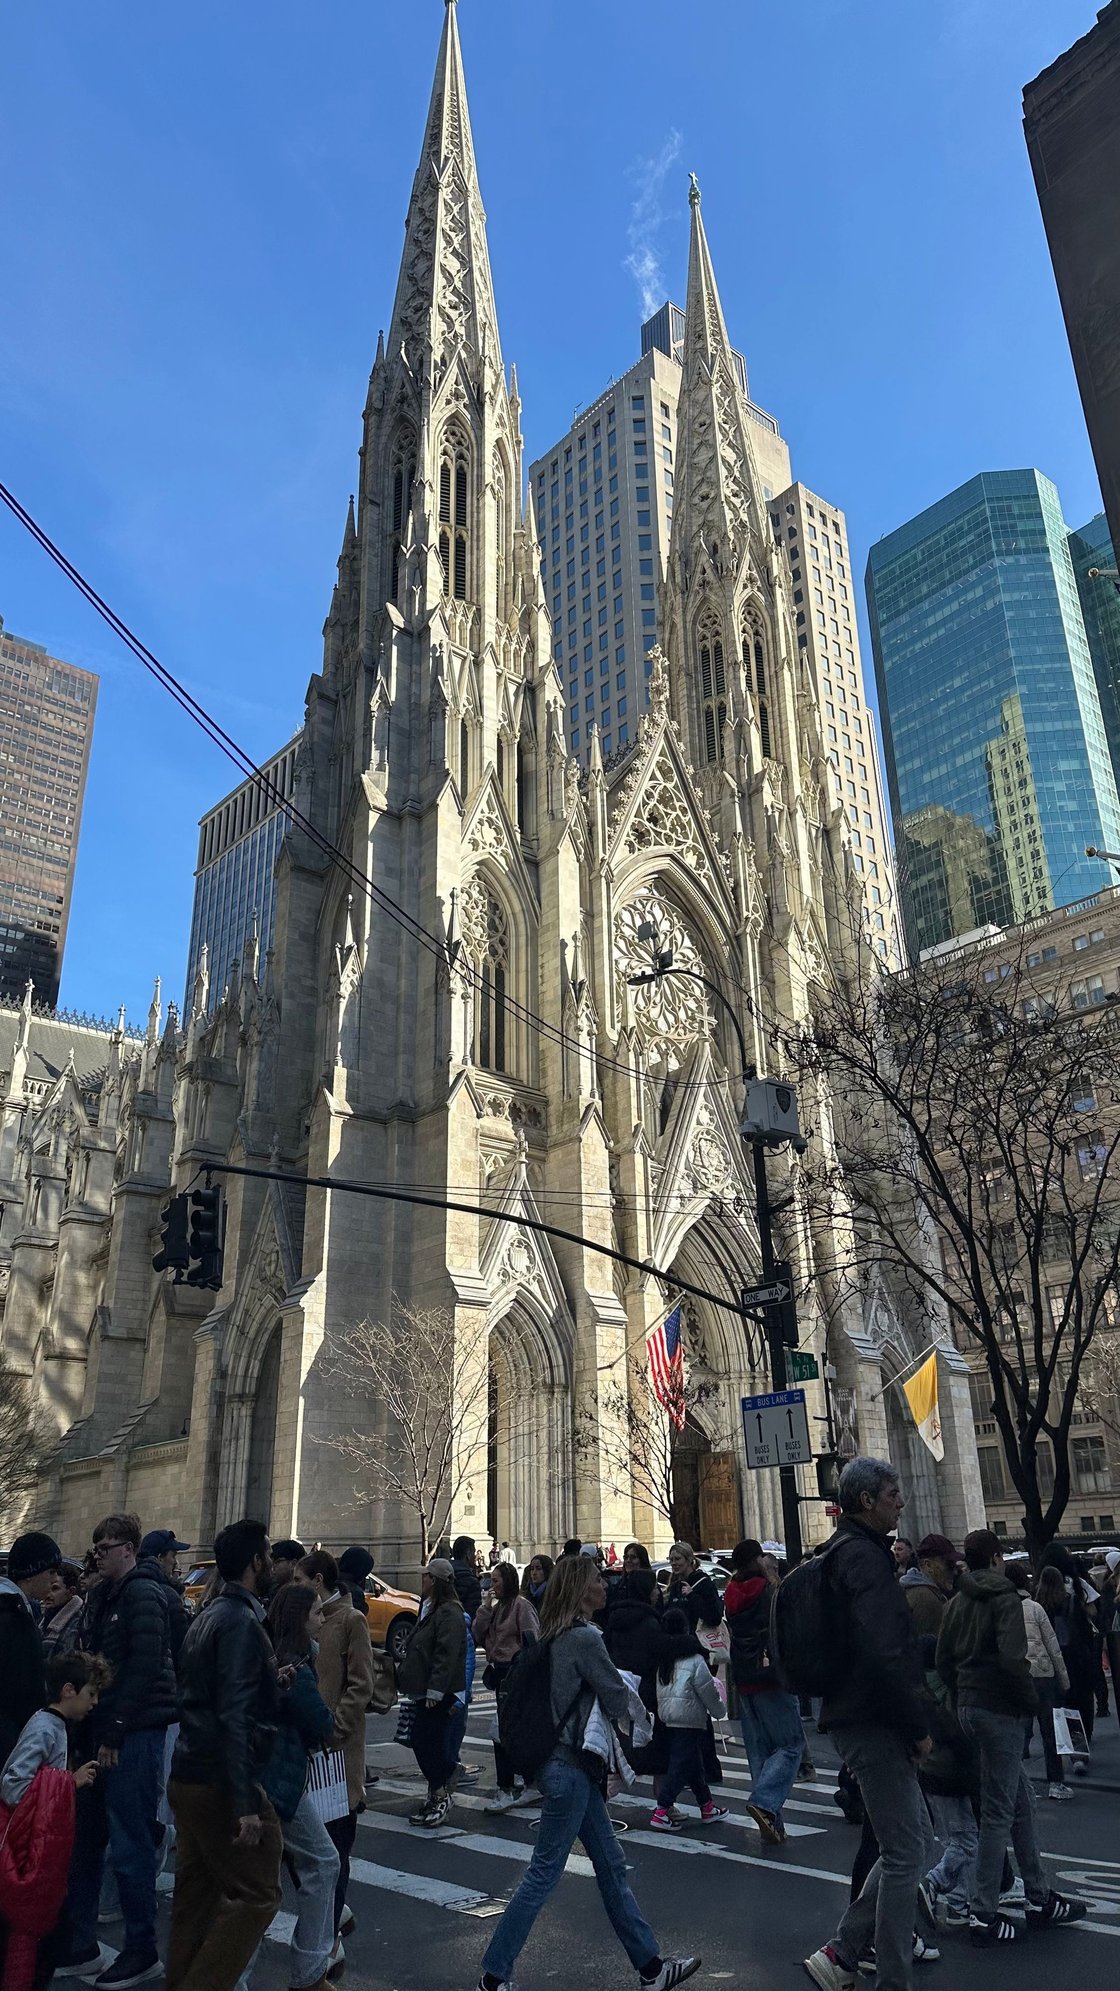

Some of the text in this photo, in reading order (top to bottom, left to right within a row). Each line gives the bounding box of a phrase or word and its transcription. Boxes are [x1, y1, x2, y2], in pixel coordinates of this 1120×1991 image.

[745, 1286, 784, 1303] ONE WAY
[793, 1366, 800, 1380] W
[802, 1364, 811, 1379] 51
[757, 1394, 789, 1407] BUS LANE
[754, 1444, 770, 1455] BUSES
[784, 1440, 801, 1451] BUSES
[756, 1455, 770, 1465] ONLY
[787, 1451, 801, 1461] ONLY
